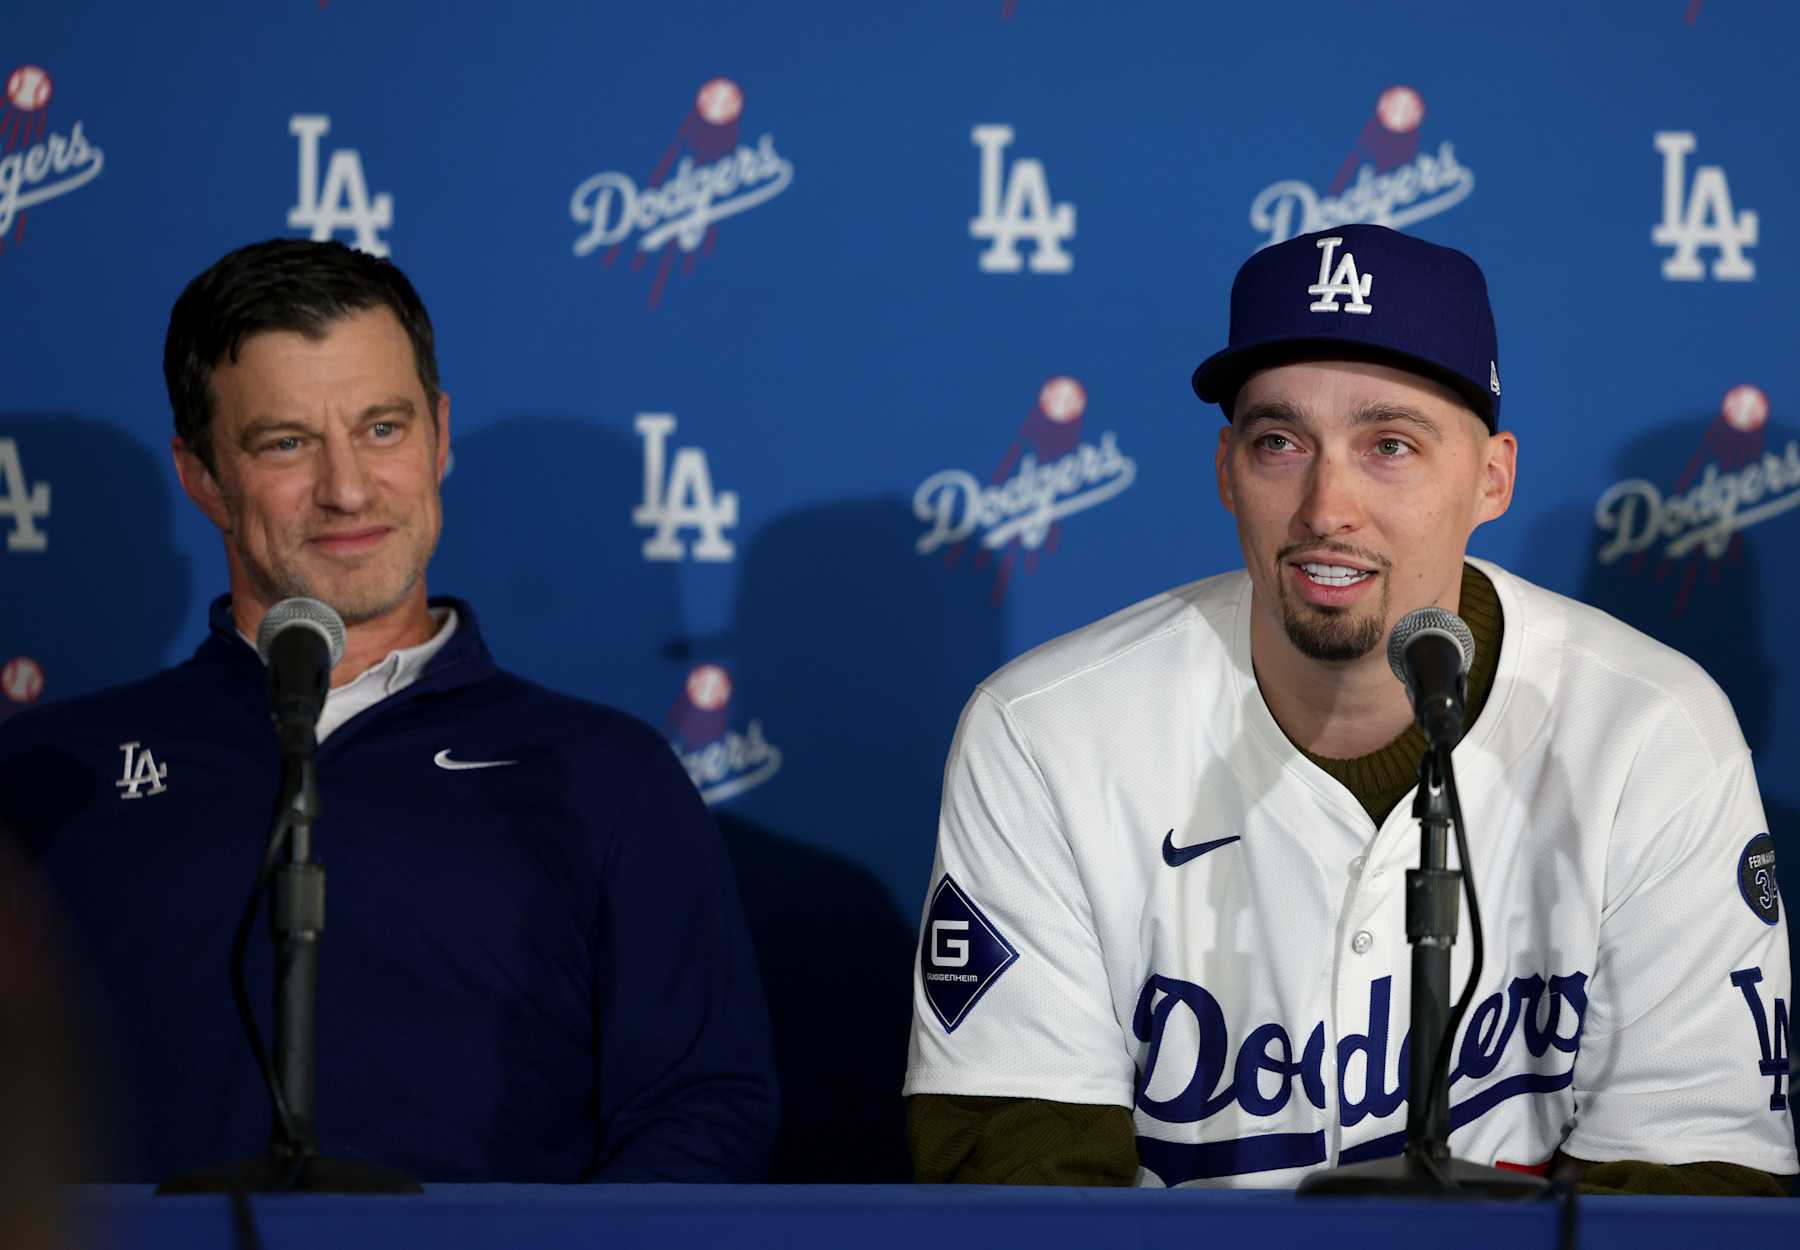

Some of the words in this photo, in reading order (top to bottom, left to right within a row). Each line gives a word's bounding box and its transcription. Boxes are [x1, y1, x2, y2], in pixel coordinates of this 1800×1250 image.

[0, 121, 104, 239] gers
[287, 114, 393, 258] LA
[570, 134, 794, 257] Dodgers
[969, 124, 1076, 273] LA
[1651, 131, 1759, 282] LA
[1307, 236, 1373, 315] LA
[633, 413, 739, 562] LA
[913, 431, 1137, 554] Dodgers
[115, 741, 168, 800] LA
[931, 919, 969, 968] G
[1133, 971, 1589, 1130] Doders
